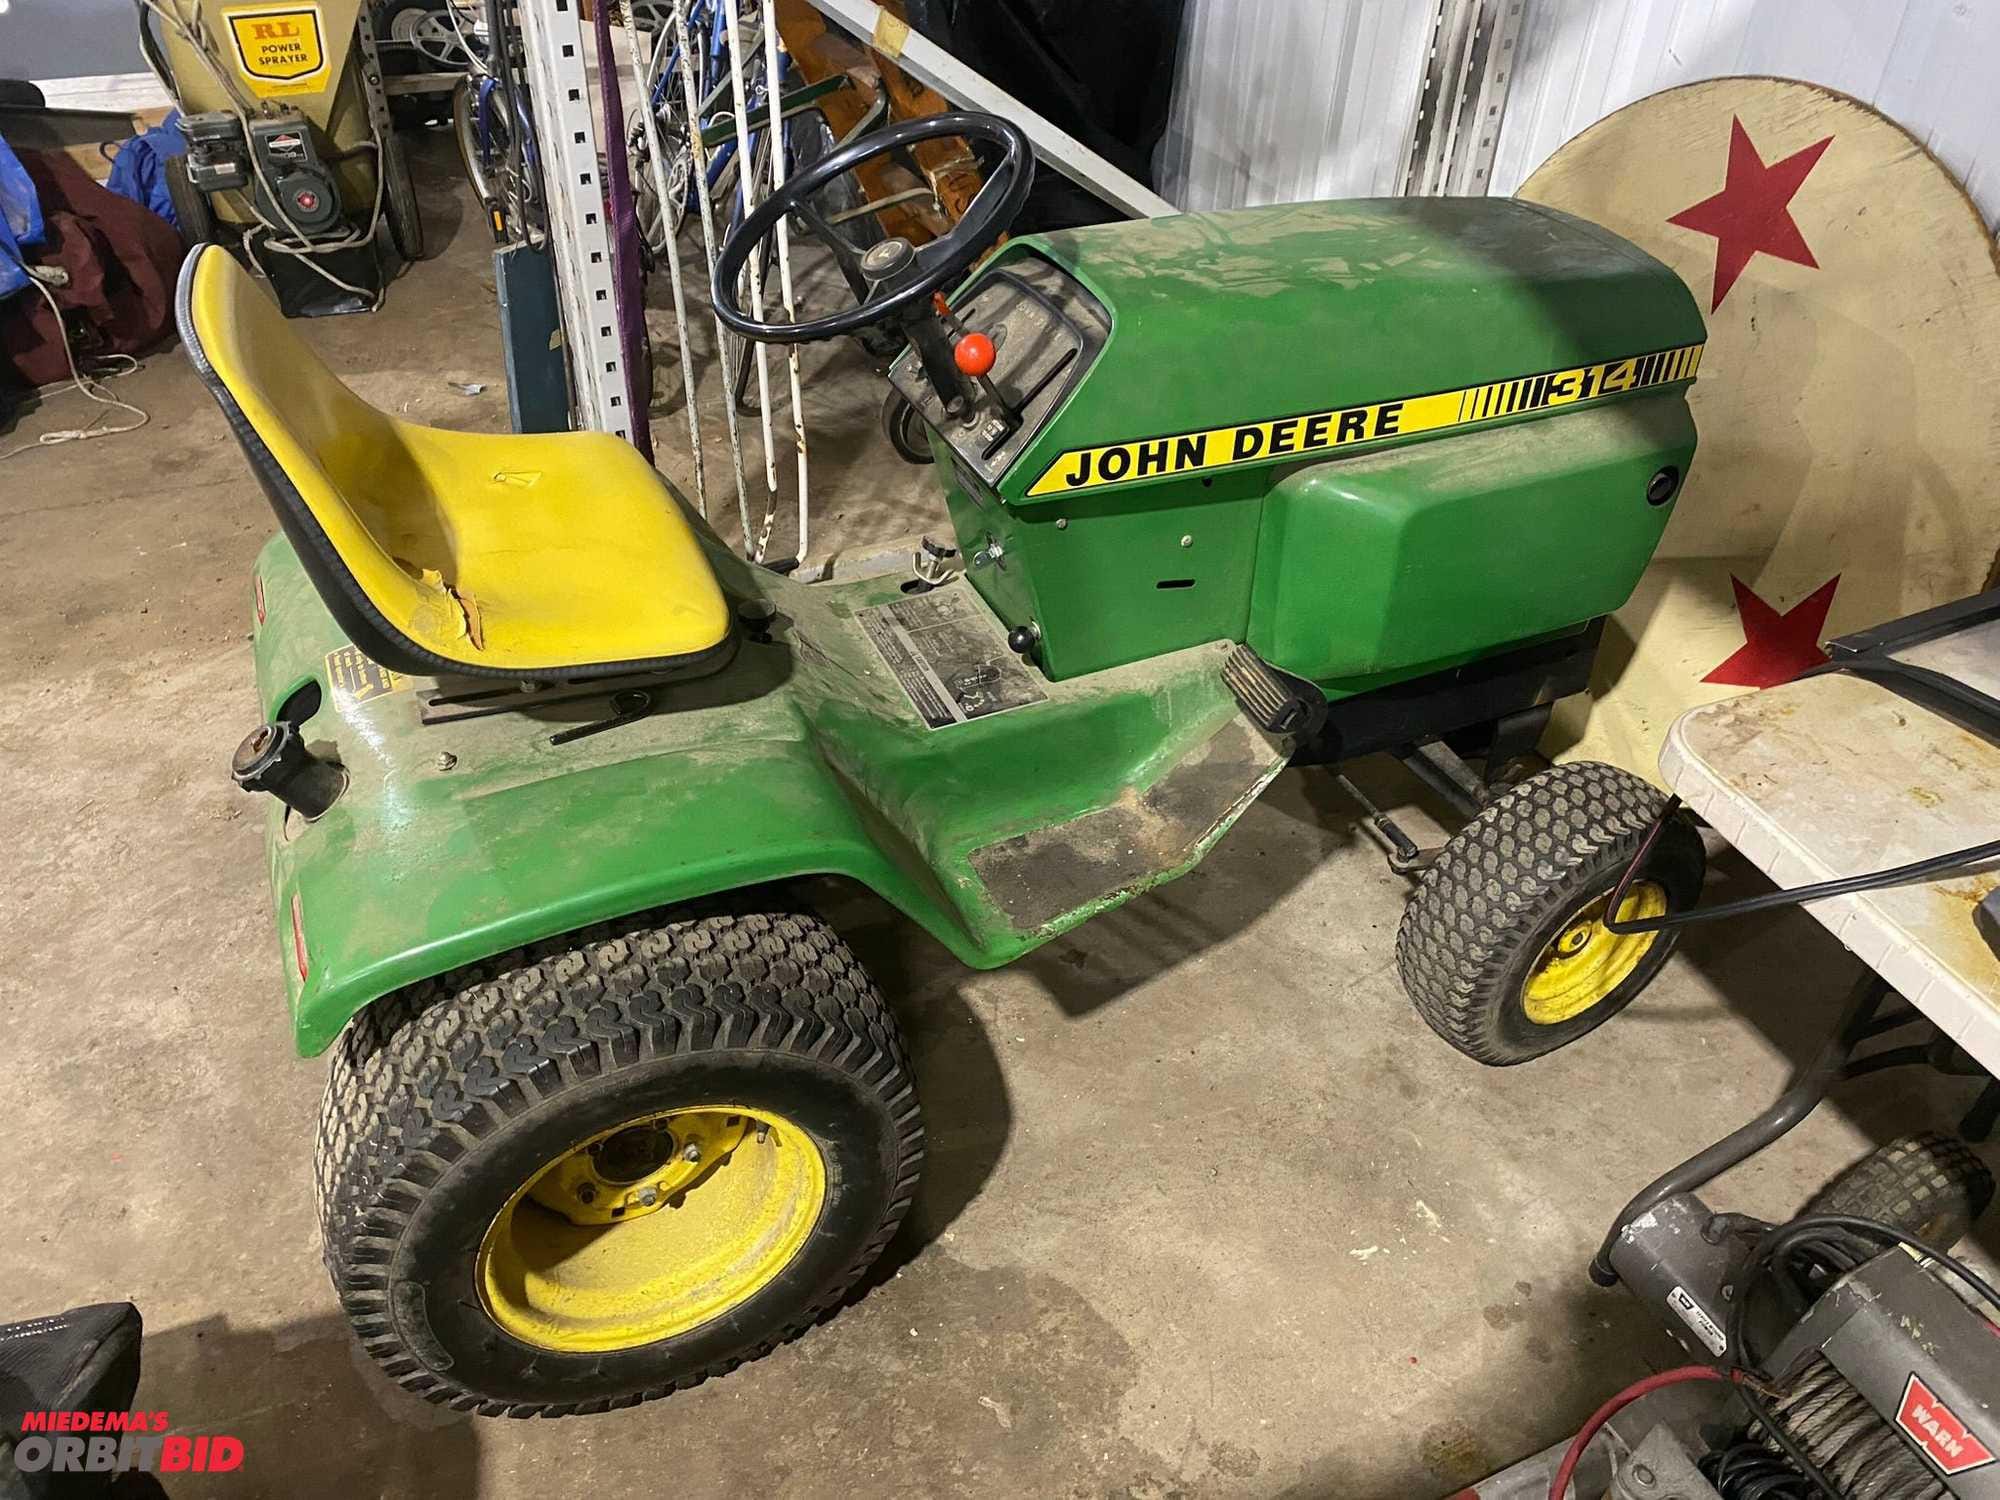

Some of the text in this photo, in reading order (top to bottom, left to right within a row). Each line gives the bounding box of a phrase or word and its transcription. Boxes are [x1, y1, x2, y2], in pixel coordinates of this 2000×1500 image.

[251, 22, 300, 40] RL
[258, 54, 308, 65] SPRAYER
[261, 42, 302, 54] POWER
[1548, 358, 1637, 406] 314
[1065, 402, 1404, 488] JOHN DEERE
[1911, 1403, 1965, 1458] WARN
